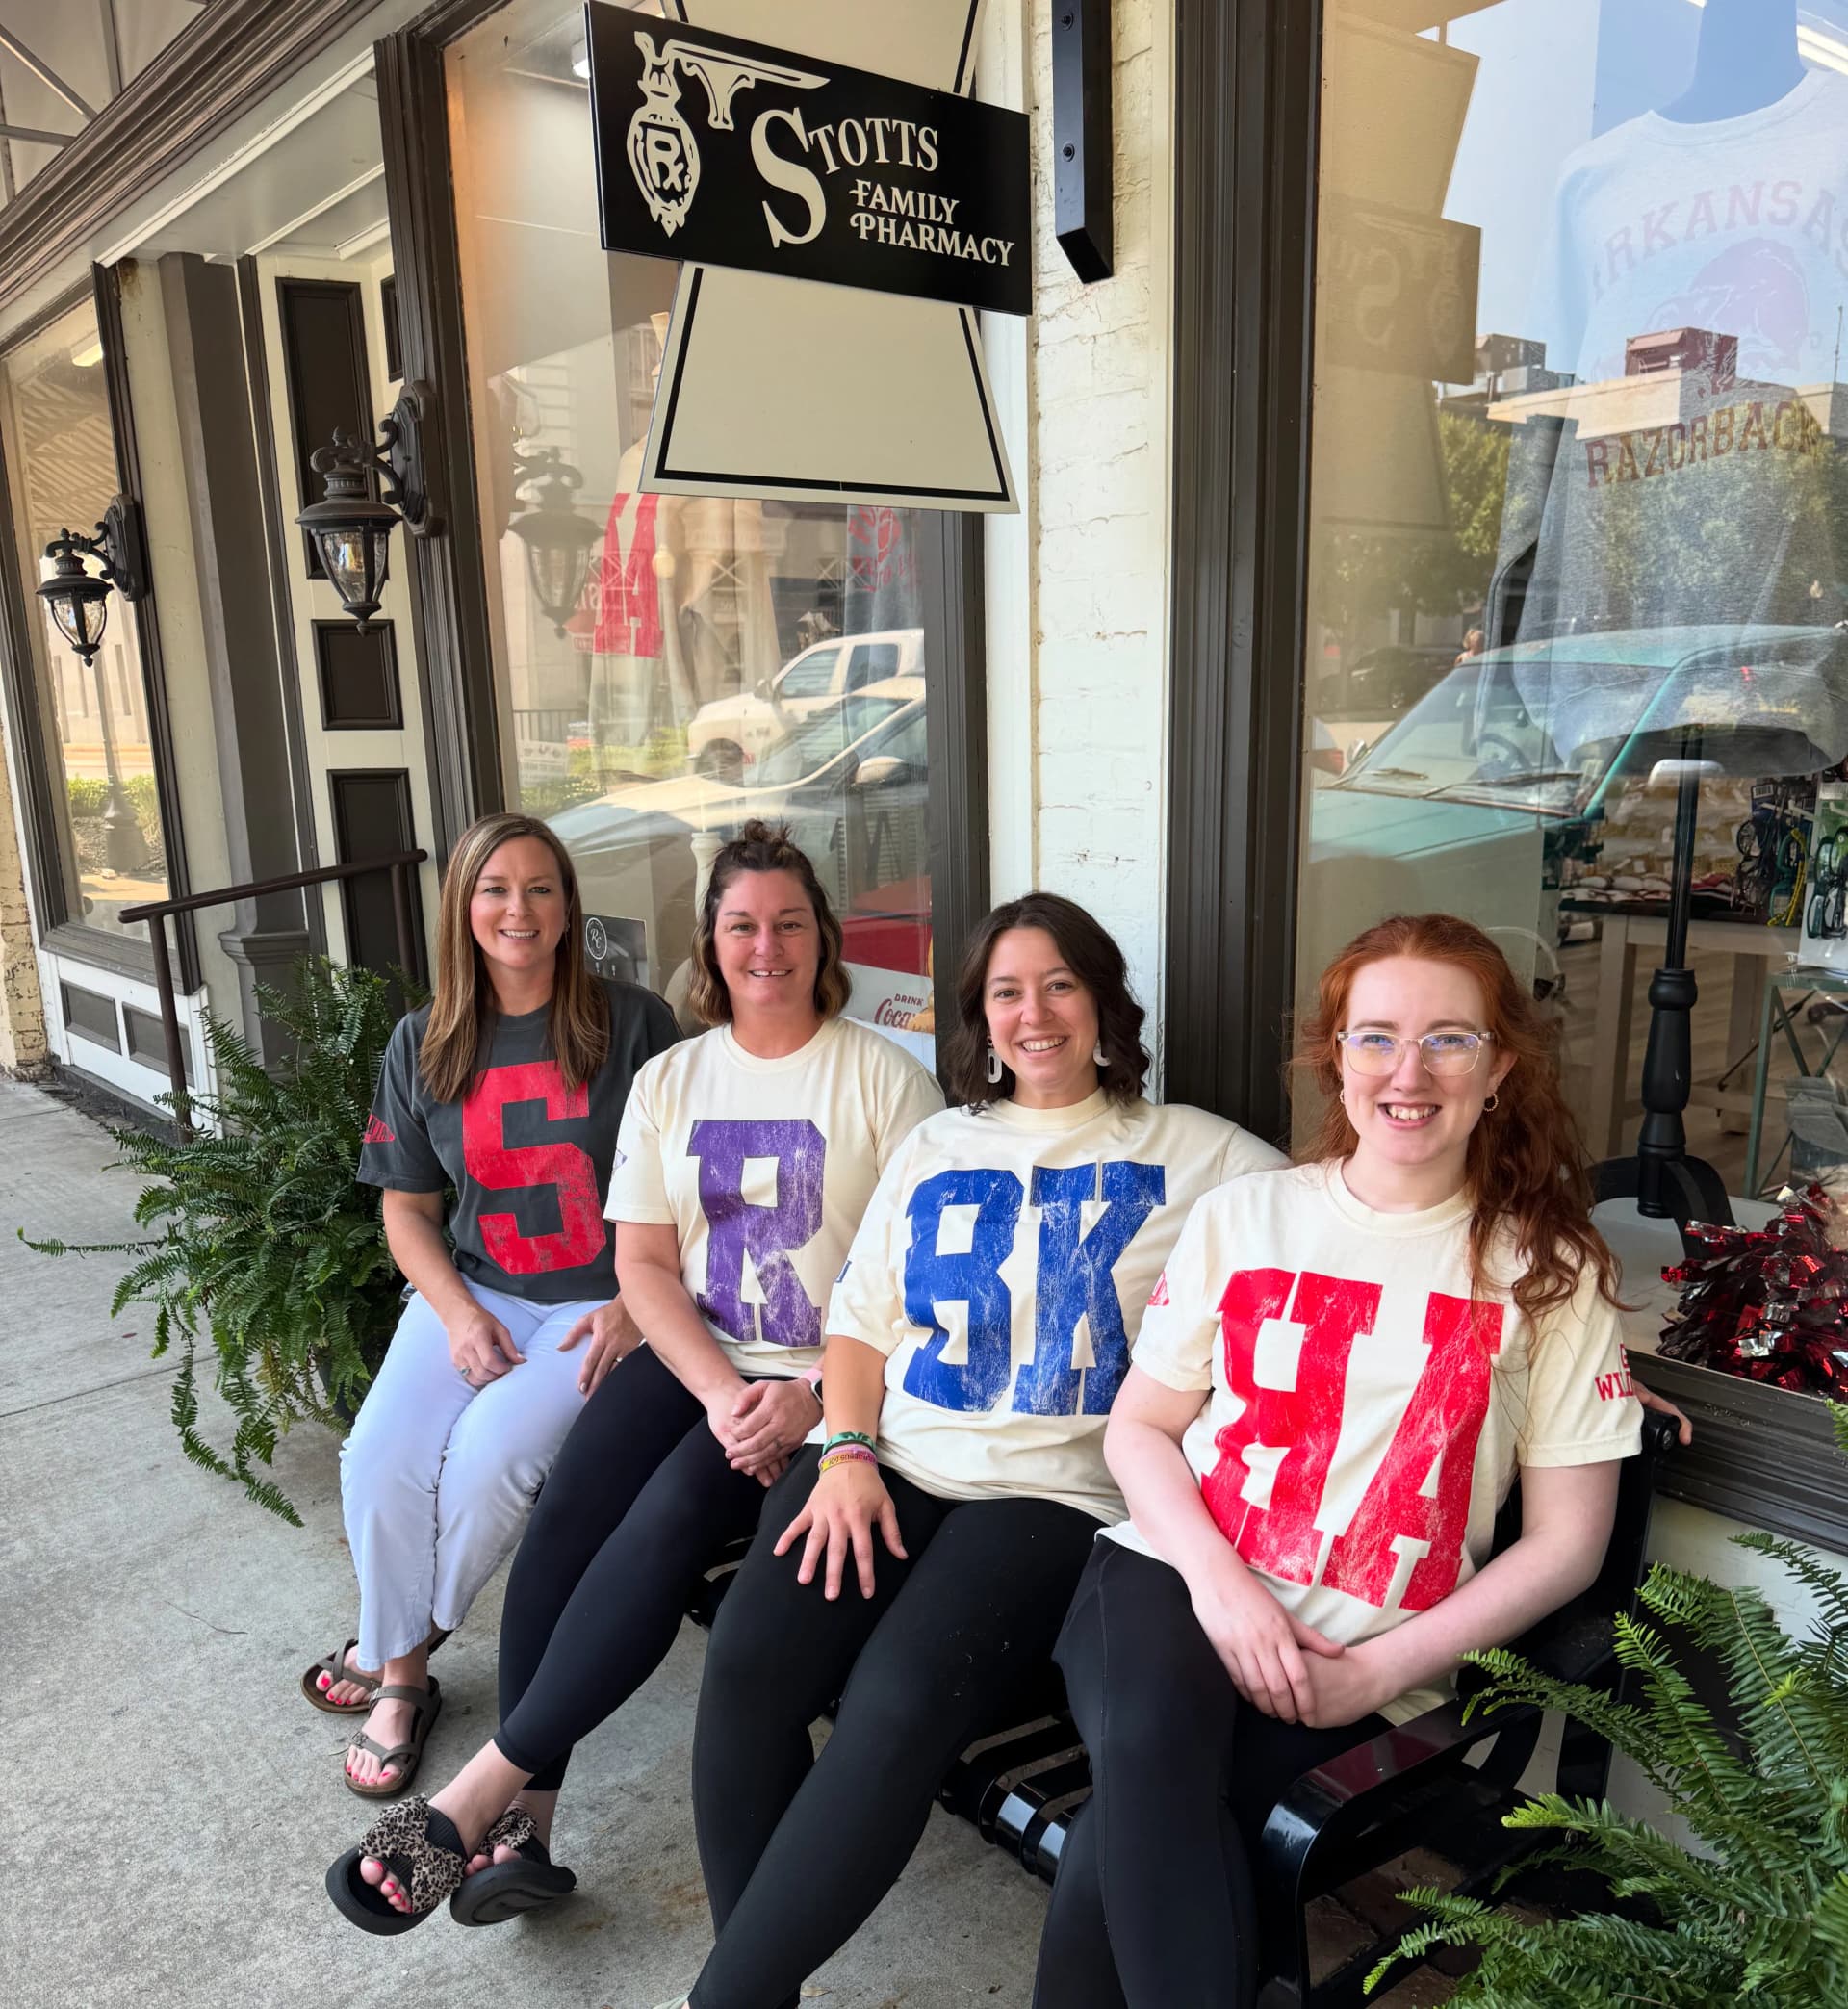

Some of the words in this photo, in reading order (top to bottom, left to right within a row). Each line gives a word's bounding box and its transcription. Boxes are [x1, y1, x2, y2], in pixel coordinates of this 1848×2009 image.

[750, 106, 939, 248] STOTTS
[848, 178, 961, 225] FAMILY
[848, 211, 1016, 267] PHARMACY
[894, 993, 924, 1007] DRINK
[462, 1060, 606, 1275] S
[686, 1119, 827, 1347] R
